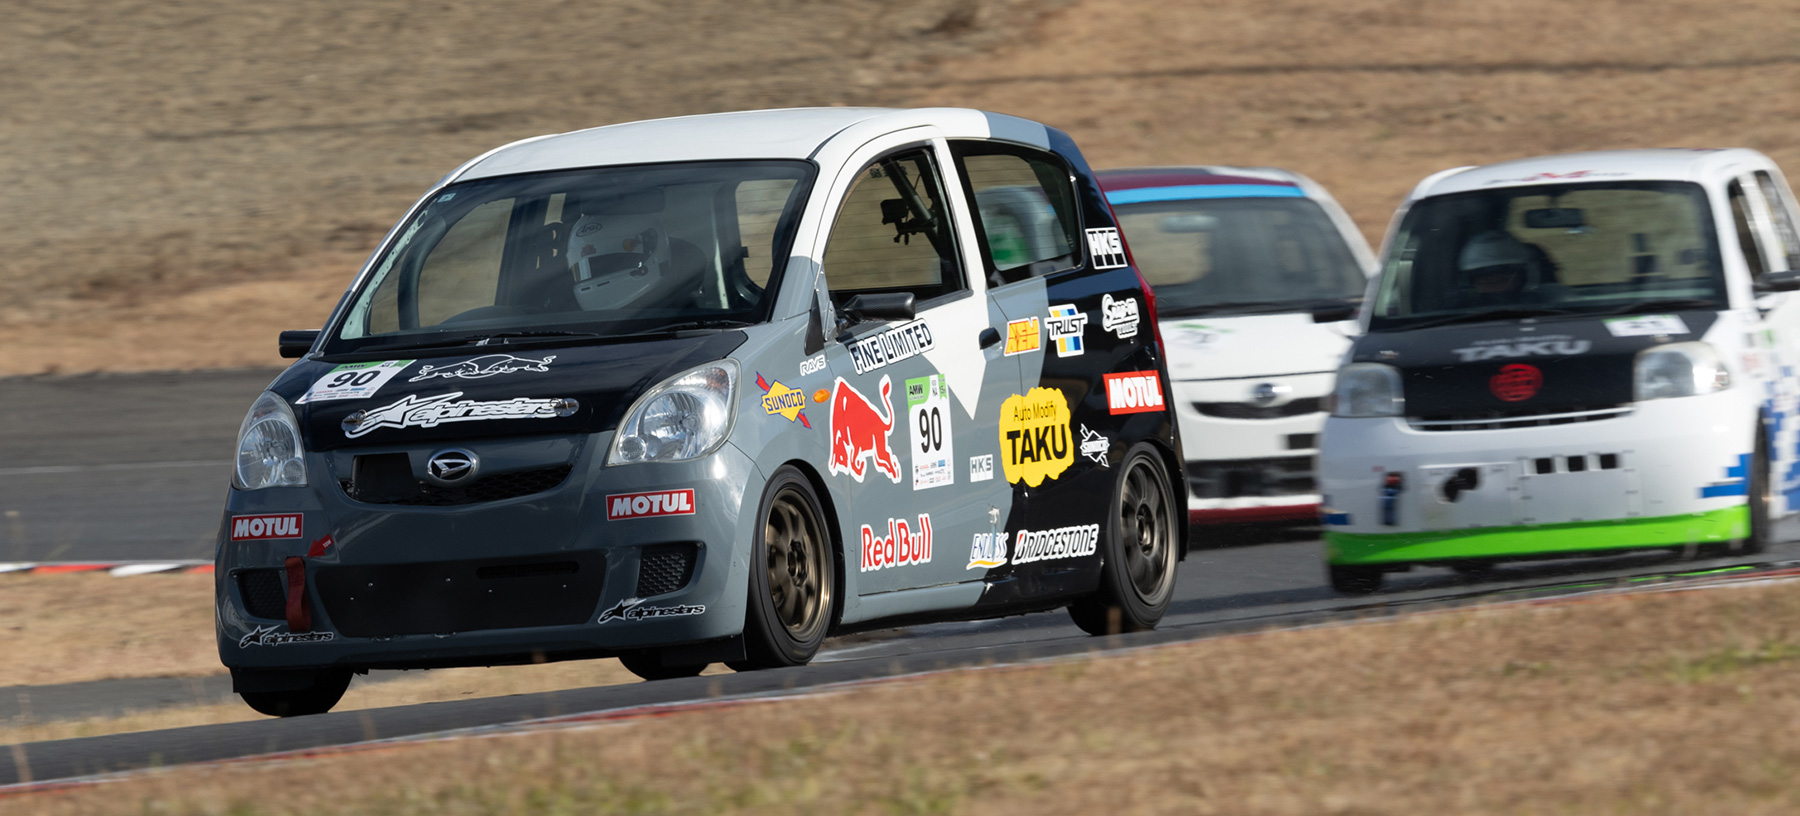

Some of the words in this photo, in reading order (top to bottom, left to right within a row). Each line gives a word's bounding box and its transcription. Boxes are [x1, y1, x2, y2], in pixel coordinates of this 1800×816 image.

[1005, 318, 1039, 354] AEM
[1047, 316, 1086, 337] TRUST
[850, 339, 884, 371] FINE
[885, 323, 933, 361] LIMITED
[1454, 339, 1592, 362] TAKU
[801, 357, 825, 374] RAYS
[327, 370, 381, 389] 90
[764, 391, 804, 412] SUNOCO
[1108, 375, 1164, 409] MOTUL
[1013, 405, 1032, 422] Auto
[1033, 400, 1057, 422] Modify
[919, 406, 942, 454] 90
[1006, 423, 1068, 466] TAKU
[971, 457, 992, 475] HKS
[611, 492, 691, 517] MOTUL
[233, 516, 300, 538] MOTUL
[861, 521, 895, 569] Red
[896, 516, 932, 564] Bull
[1014, 526, 1098, 562] BRIDGESTONE
